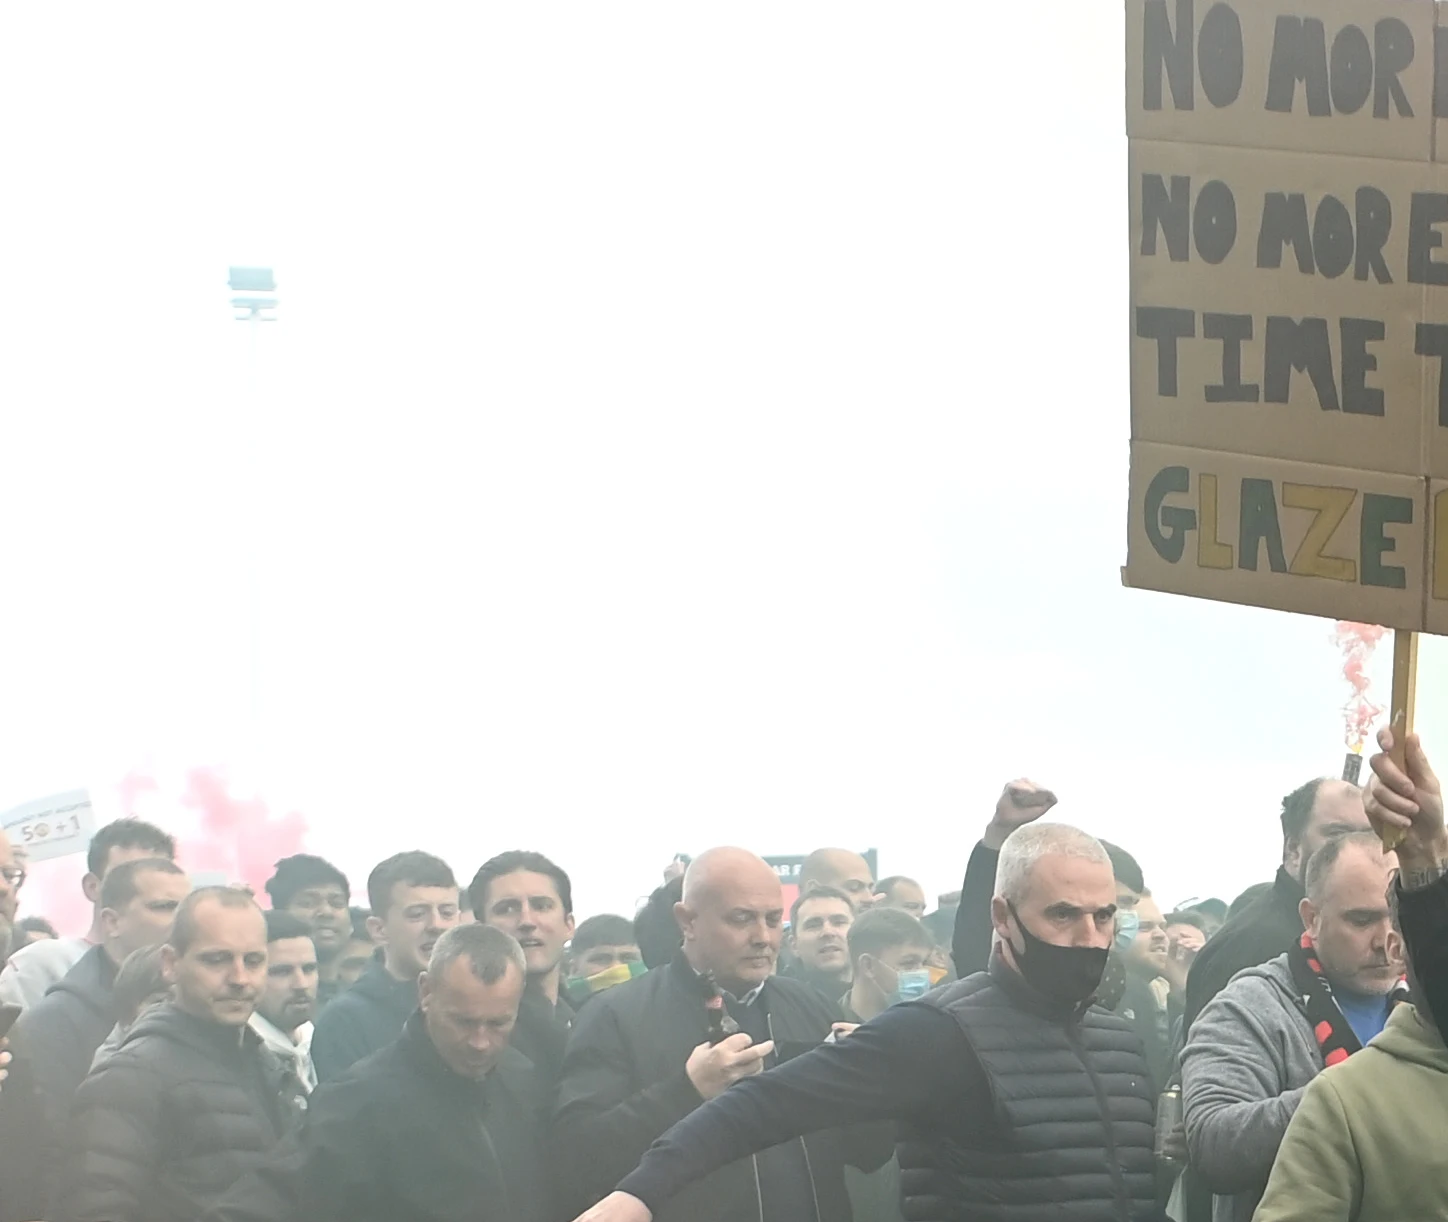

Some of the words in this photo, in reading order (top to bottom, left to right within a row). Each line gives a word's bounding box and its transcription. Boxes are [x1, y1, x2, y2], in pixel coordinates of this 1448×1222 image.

[1142, 0, 1244, 111] NO
[1140, 173, 1237, 265] NO
[1135, 305, 1386, 417] TIME
